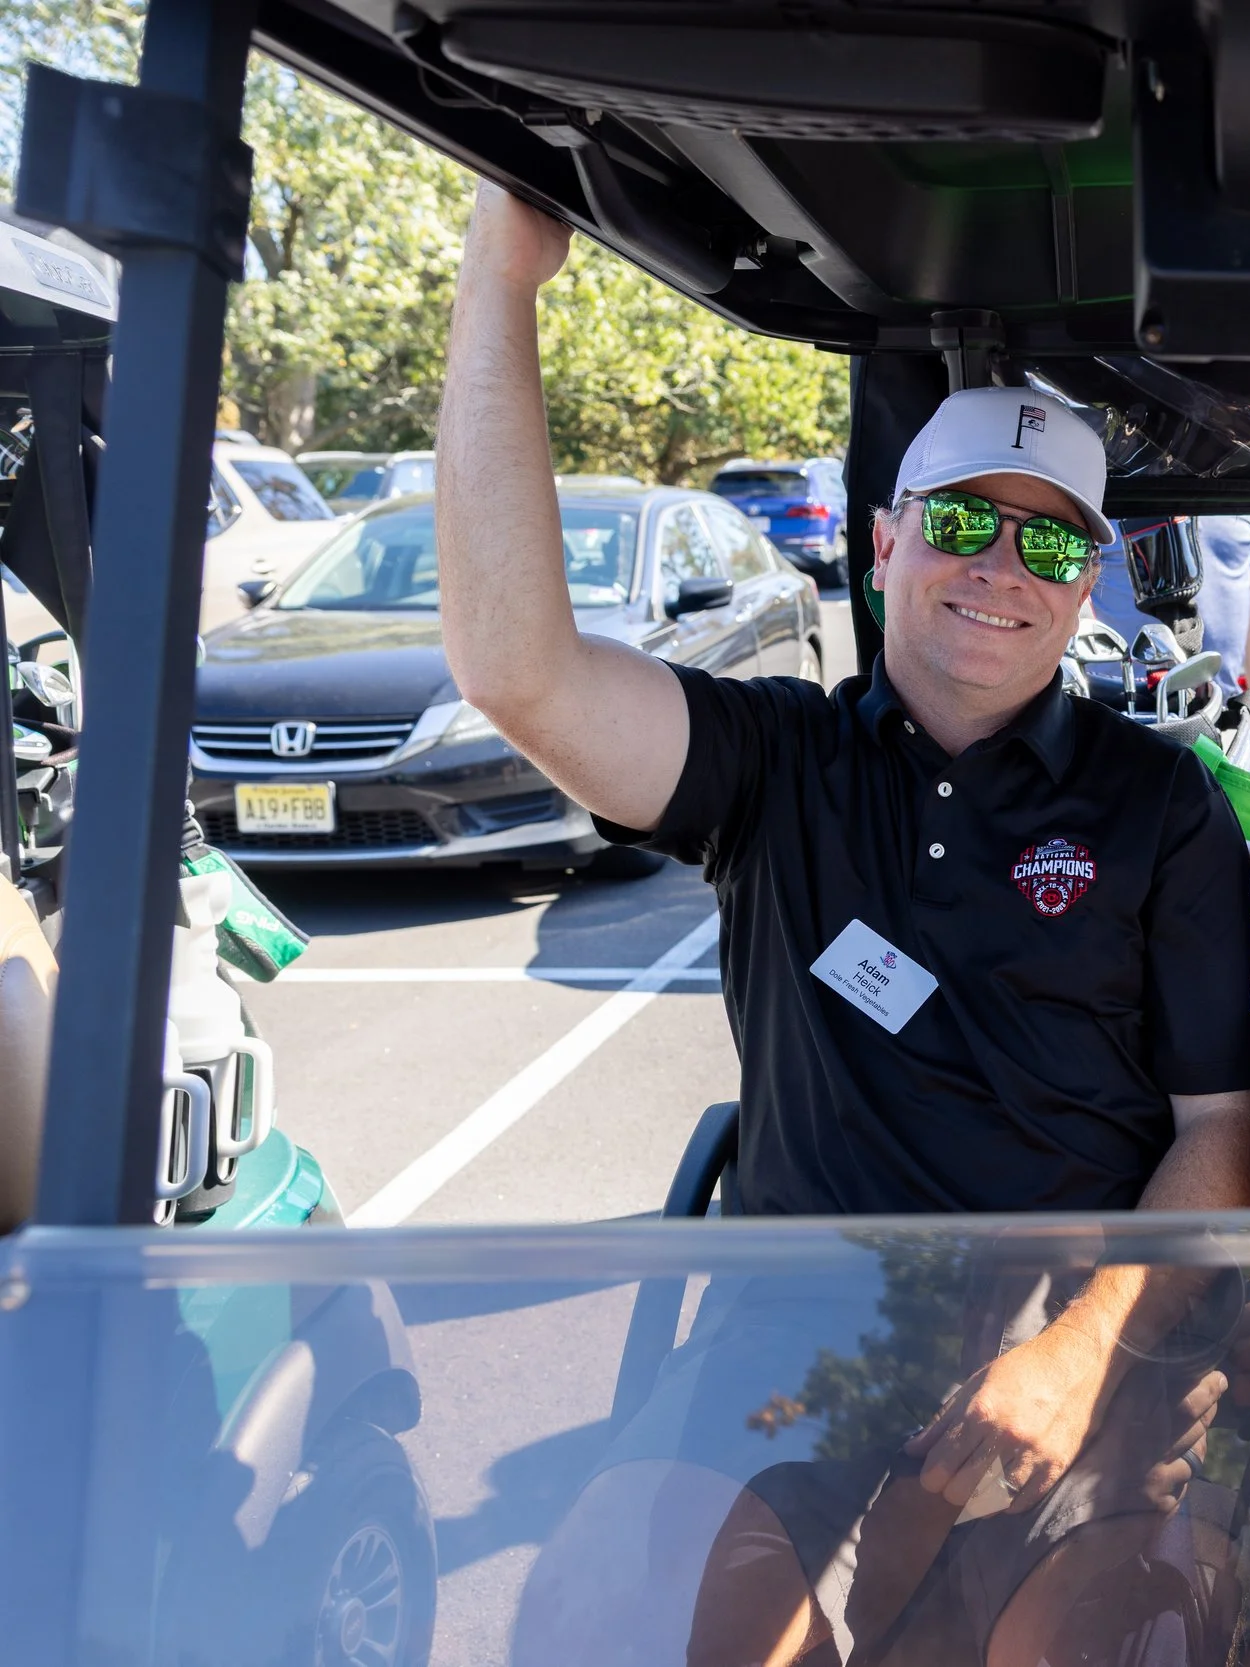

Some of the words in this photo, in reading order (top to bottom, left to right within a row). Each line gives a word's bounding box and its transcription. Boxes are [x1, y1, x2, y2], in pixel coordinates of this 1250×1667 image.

[1034, 852, 1075, 860] NATIONAL
[1013, 860, 1094, 880] CHAMPIONS
[235, 910, 280, 932] PING
[852, 971, 881, 997] Heick
[857, 959, 890, 986] Adam
[828, 969, 843, 983] Dole
[842, 978, 859, 994] Fresh
[859, 991, 890, 1017] Vegetables
